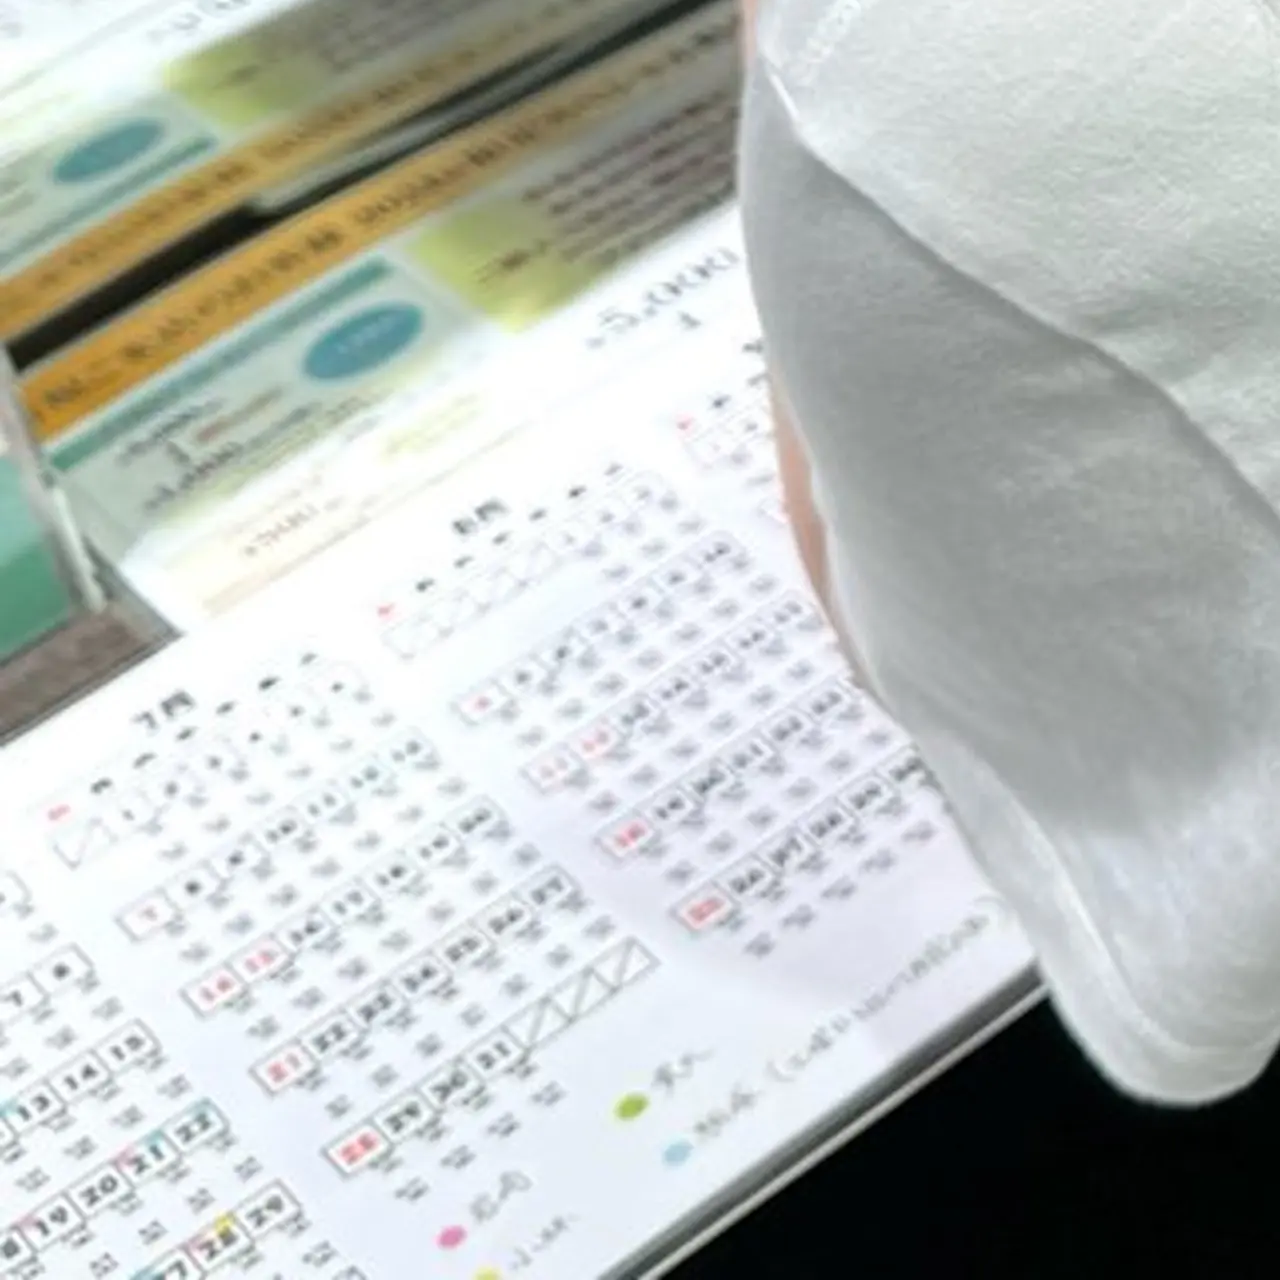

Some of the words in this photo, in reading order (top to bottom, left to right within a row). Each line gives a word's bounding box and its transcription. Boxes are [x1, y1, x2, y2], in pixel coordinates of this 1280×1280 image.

[13, 1094, 50, 1121] 13
[64, 1064, 98, 1091] 14
[110, 1035, 144, 1061] 15
[31, 1206, 68, 1237] 19
[81, 1175, 118, 1207] 20
[126, 1140, 164, 1175] 21
[176, 1109, 212, 1143] 22
[246, 1195, 284, 1228] 29
